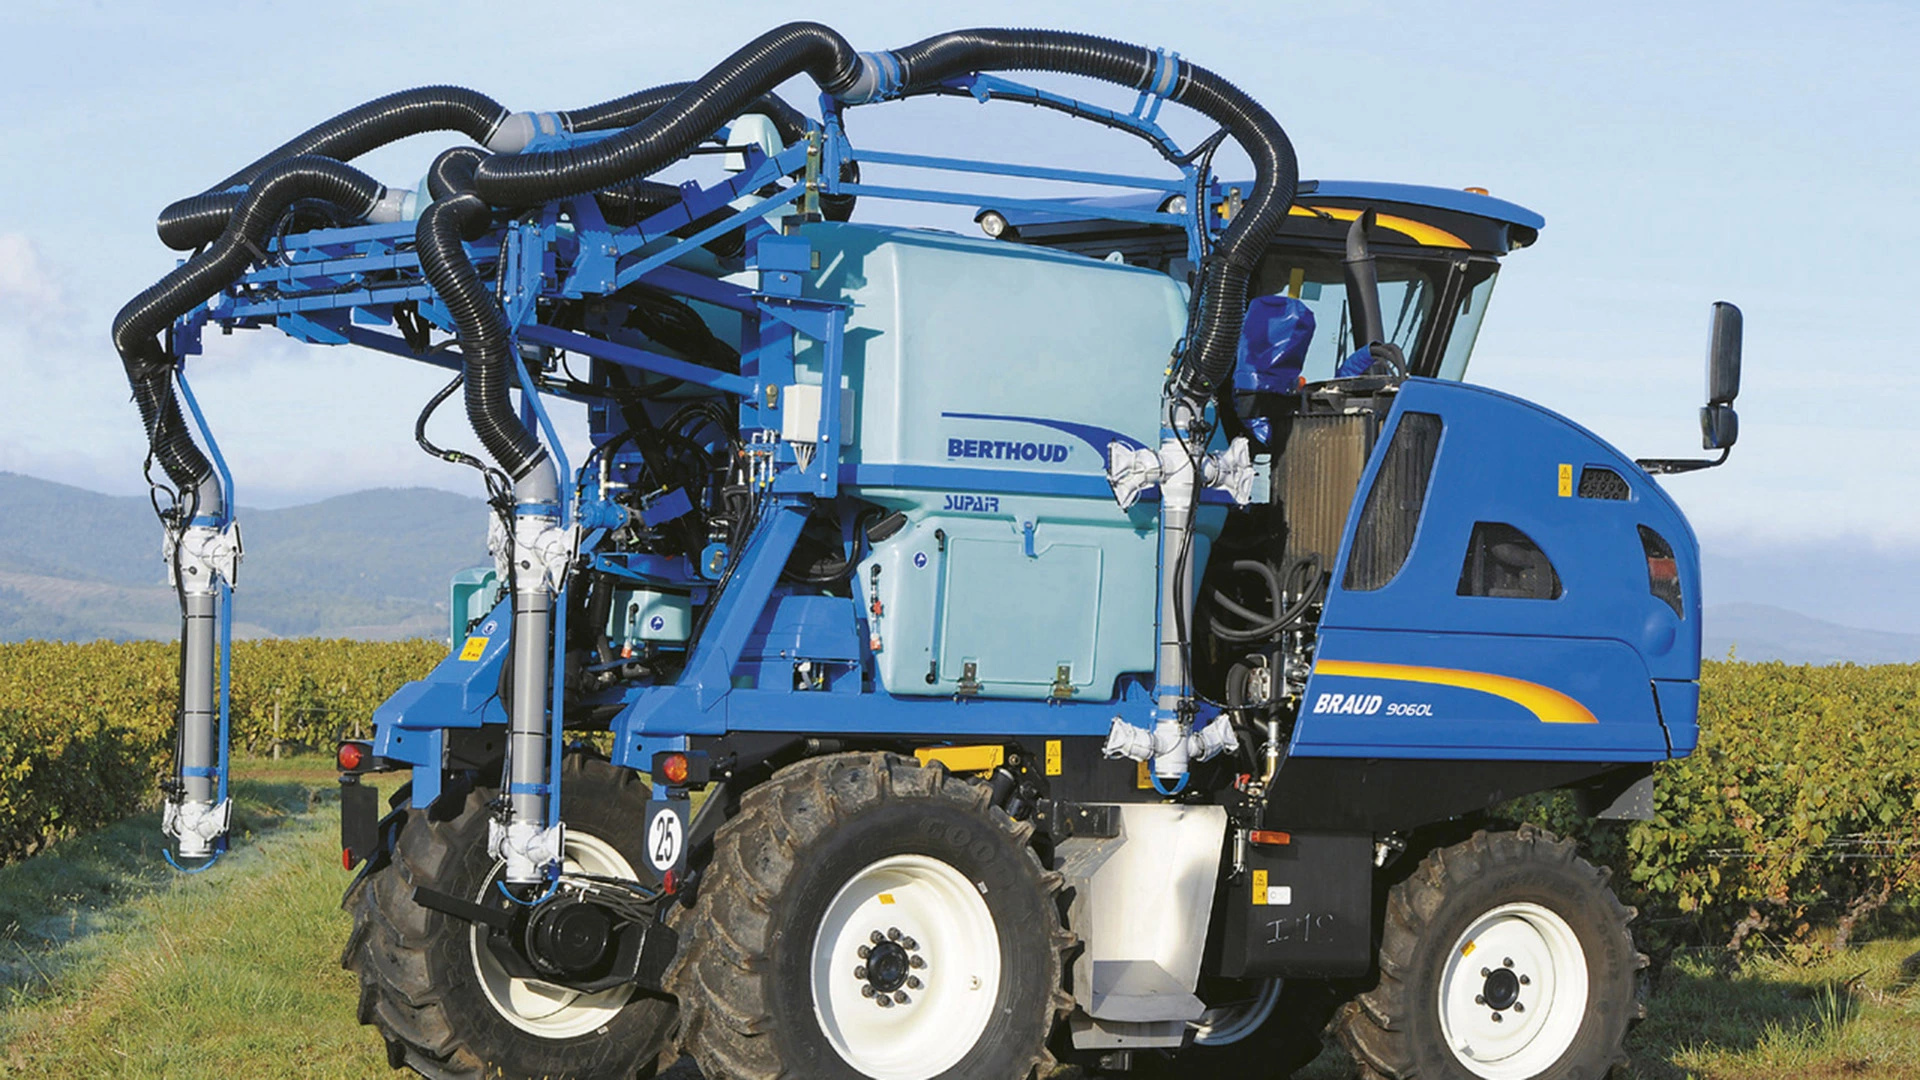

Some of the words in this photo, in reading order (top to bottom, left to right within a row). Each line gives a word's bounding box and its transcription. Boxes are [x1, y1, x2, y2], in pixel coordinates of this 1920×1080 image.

[947, 438, 1068, 463] BERTHOUD
[1313, 693, 1383, 715] BRAUD
[1385, 702, 1433, 718] 9060L
[655, 816, 674, 862] 25
